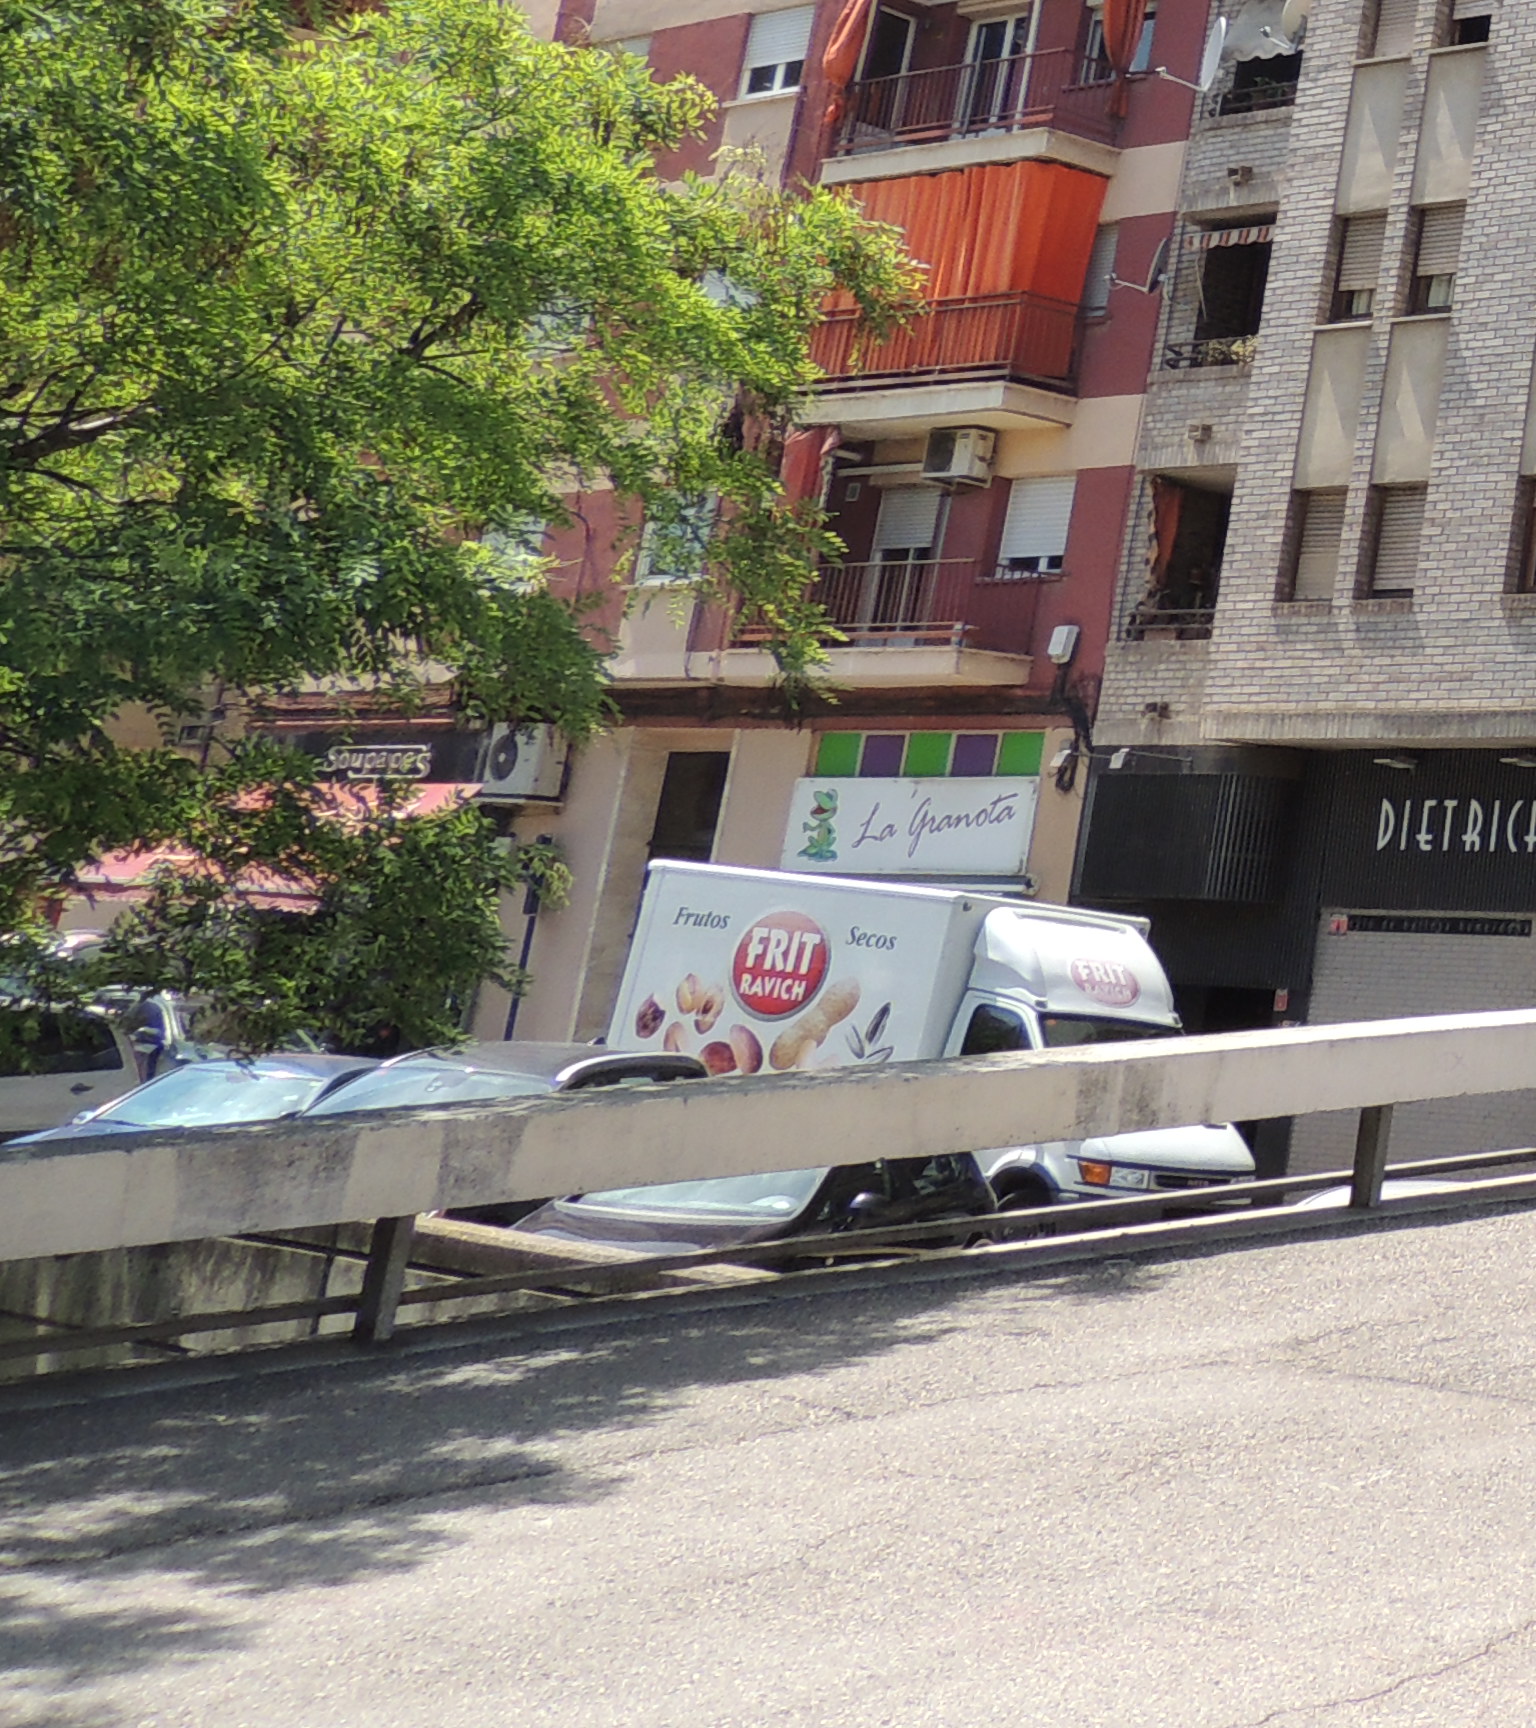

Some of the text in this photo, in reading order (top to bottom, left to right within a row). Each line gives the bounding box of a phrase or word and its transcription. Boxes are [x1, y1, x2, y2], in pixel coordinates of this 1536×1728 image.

[851, 788, 1019, 858] La Granota
[672, 906, 731, 930] Frutos
[745, 926, 823, 975] FRIT
[845, 925, 898, 952] Secos
[1074, 958, 1128, 986] FRIT
[739, 972, 807, 1002] RAVICH
